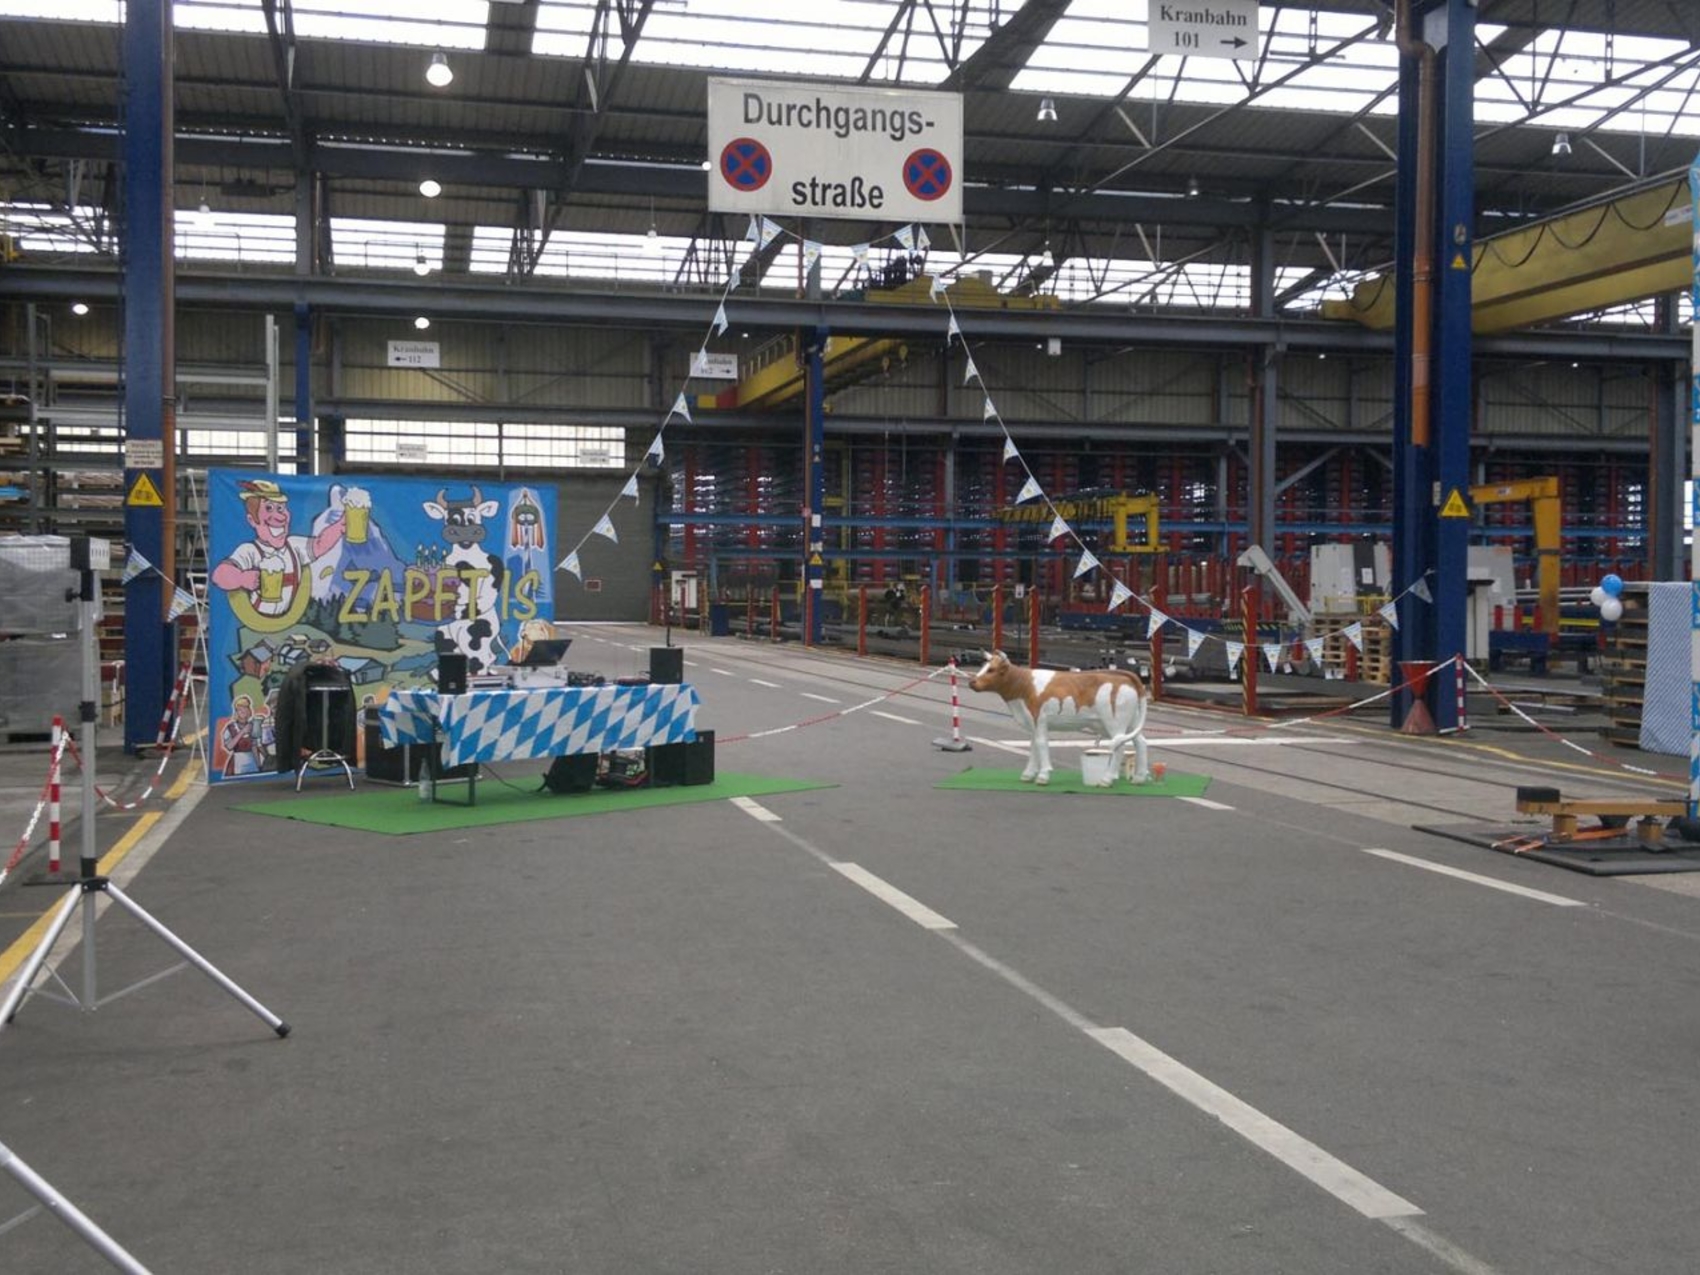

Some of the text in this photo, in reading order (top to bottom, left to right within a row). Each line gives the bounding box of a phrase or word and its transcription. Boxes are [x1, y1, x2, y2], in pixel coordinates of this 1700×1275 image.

[1161, 5, 1247, 26] Kranbahn
[1175, 31, 1199, 48] 101
[743, 92, 935, 142] Durchgangs-
[792, 176, 884, 209] straße
[502, 568, 540, 621] IS
